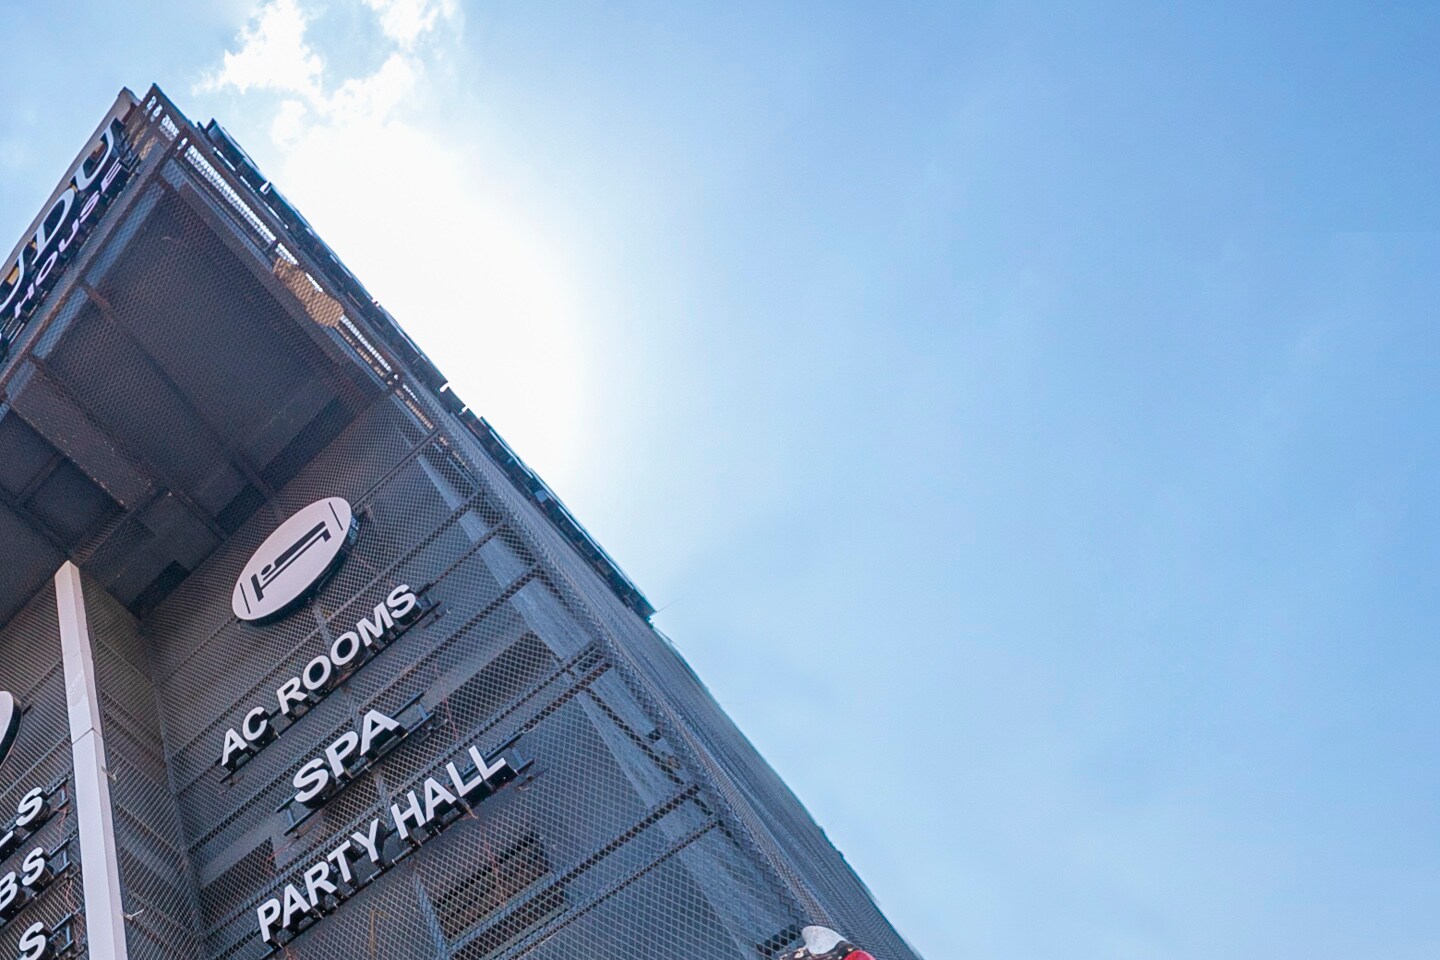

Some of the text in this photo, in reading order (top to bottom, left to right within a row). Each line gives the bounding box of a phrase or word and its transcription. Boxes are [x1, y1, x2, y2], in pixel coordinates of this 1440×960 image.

[14, 156, 122, 319] HOUSE
[221, 584, 417, 767] AC ROOMS
[293, 709, 400, 805] SPA
[256, 744, 507, 943] PARTY HALL
